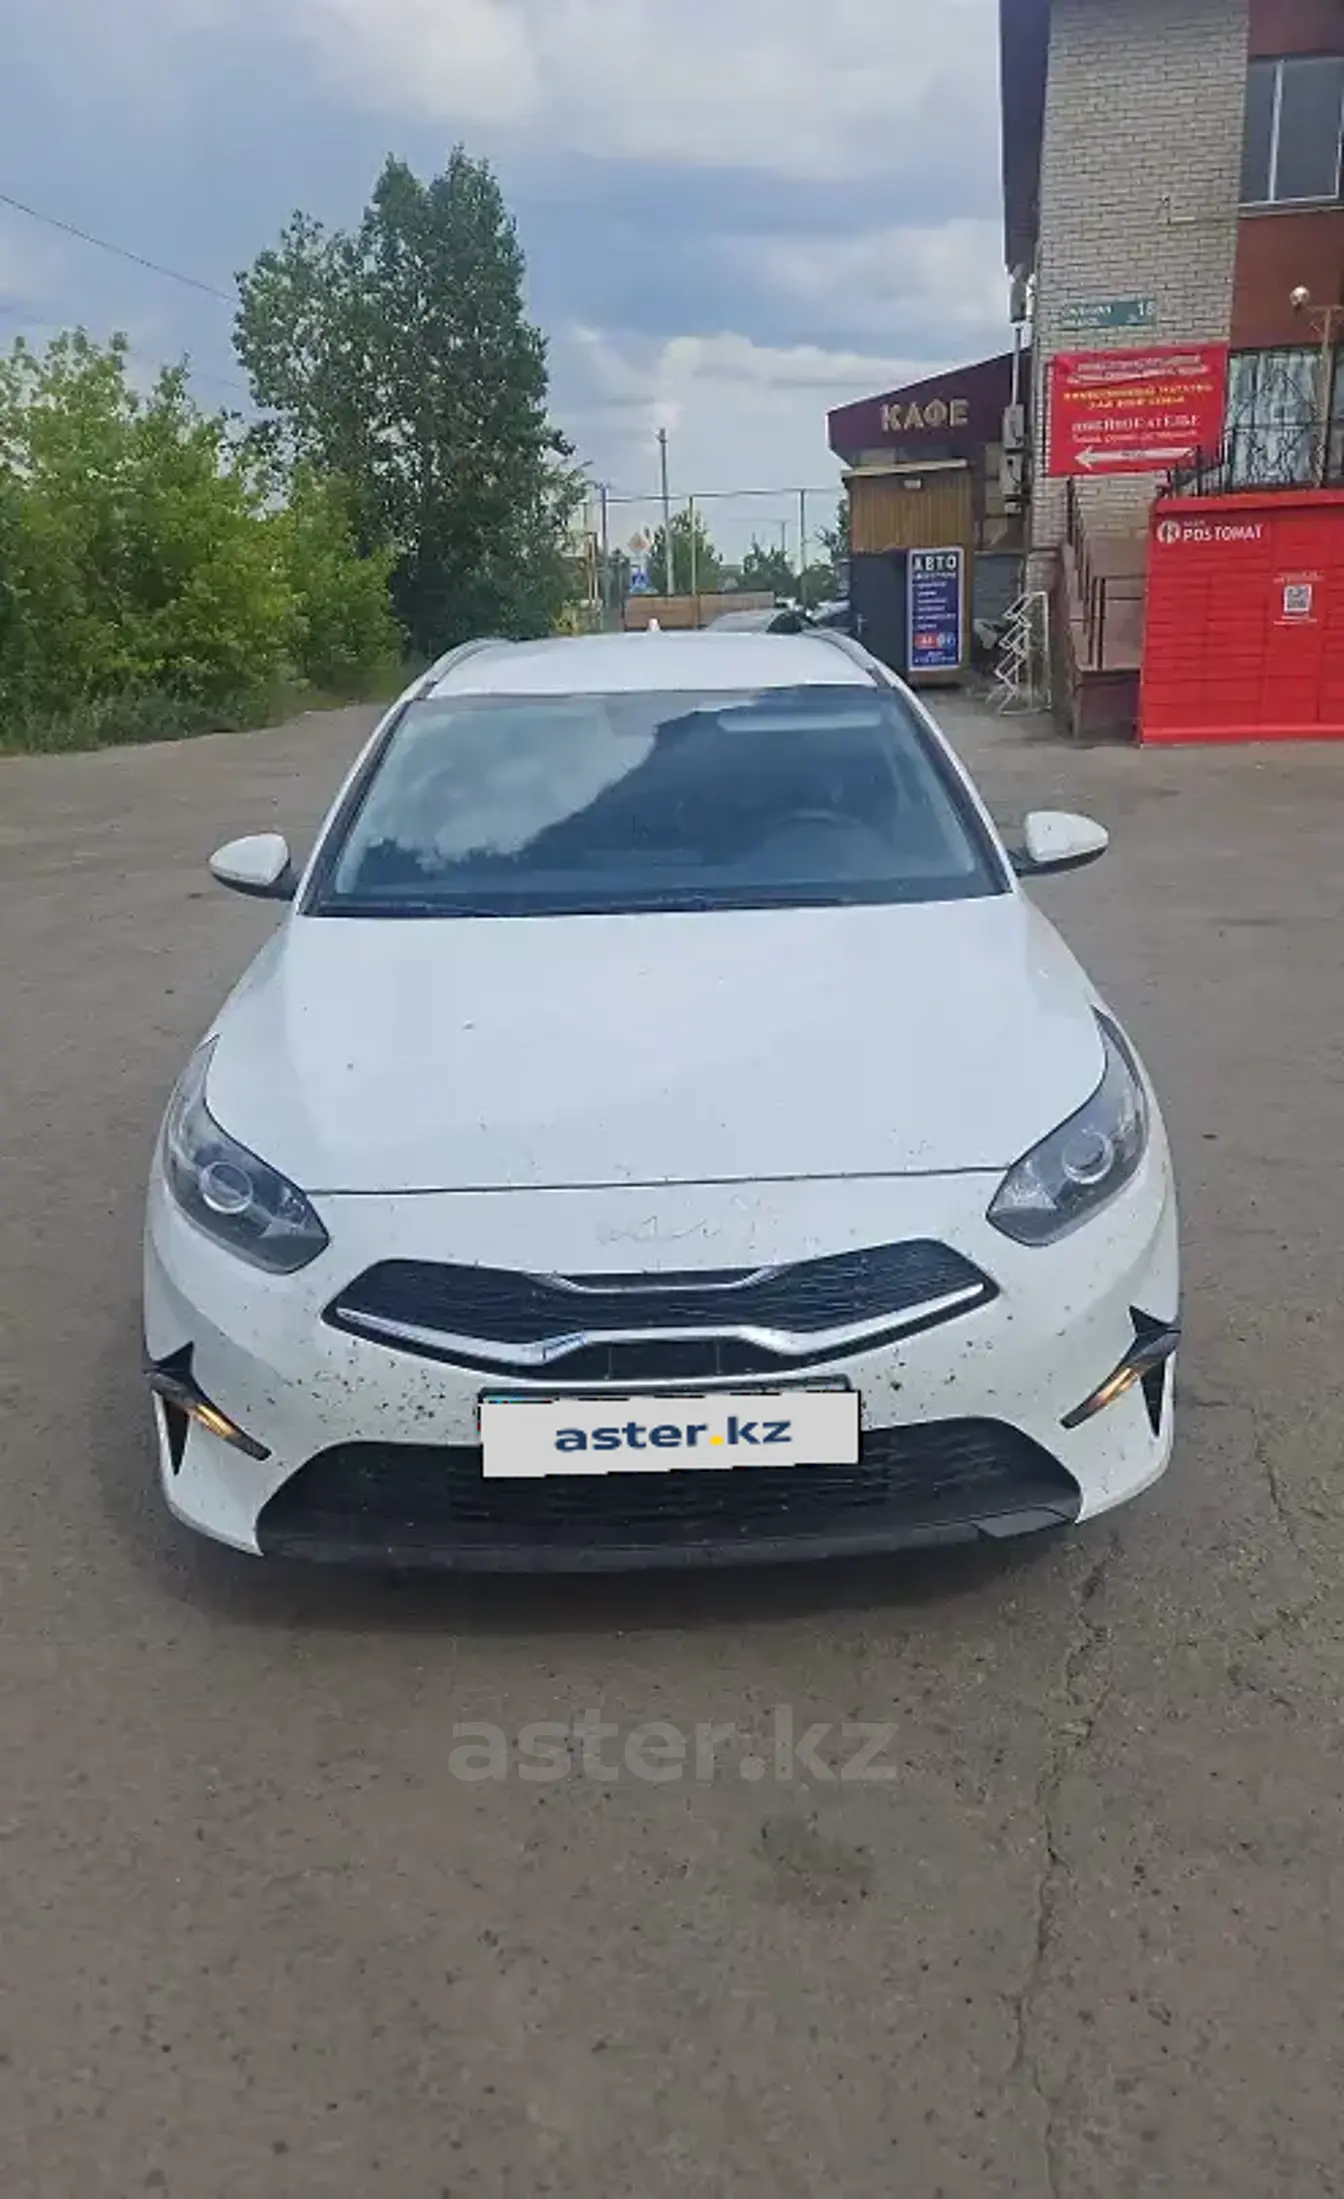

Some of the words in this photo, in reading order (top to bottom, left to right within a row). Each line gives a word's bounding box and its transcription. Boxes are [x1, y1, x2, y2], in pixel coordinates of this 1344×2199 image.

[880, 398, 969, 432] КАФЕ
[1183, 524, 1264, 542] POSTOMAT
[913, 555, 957, 571] АВТО
